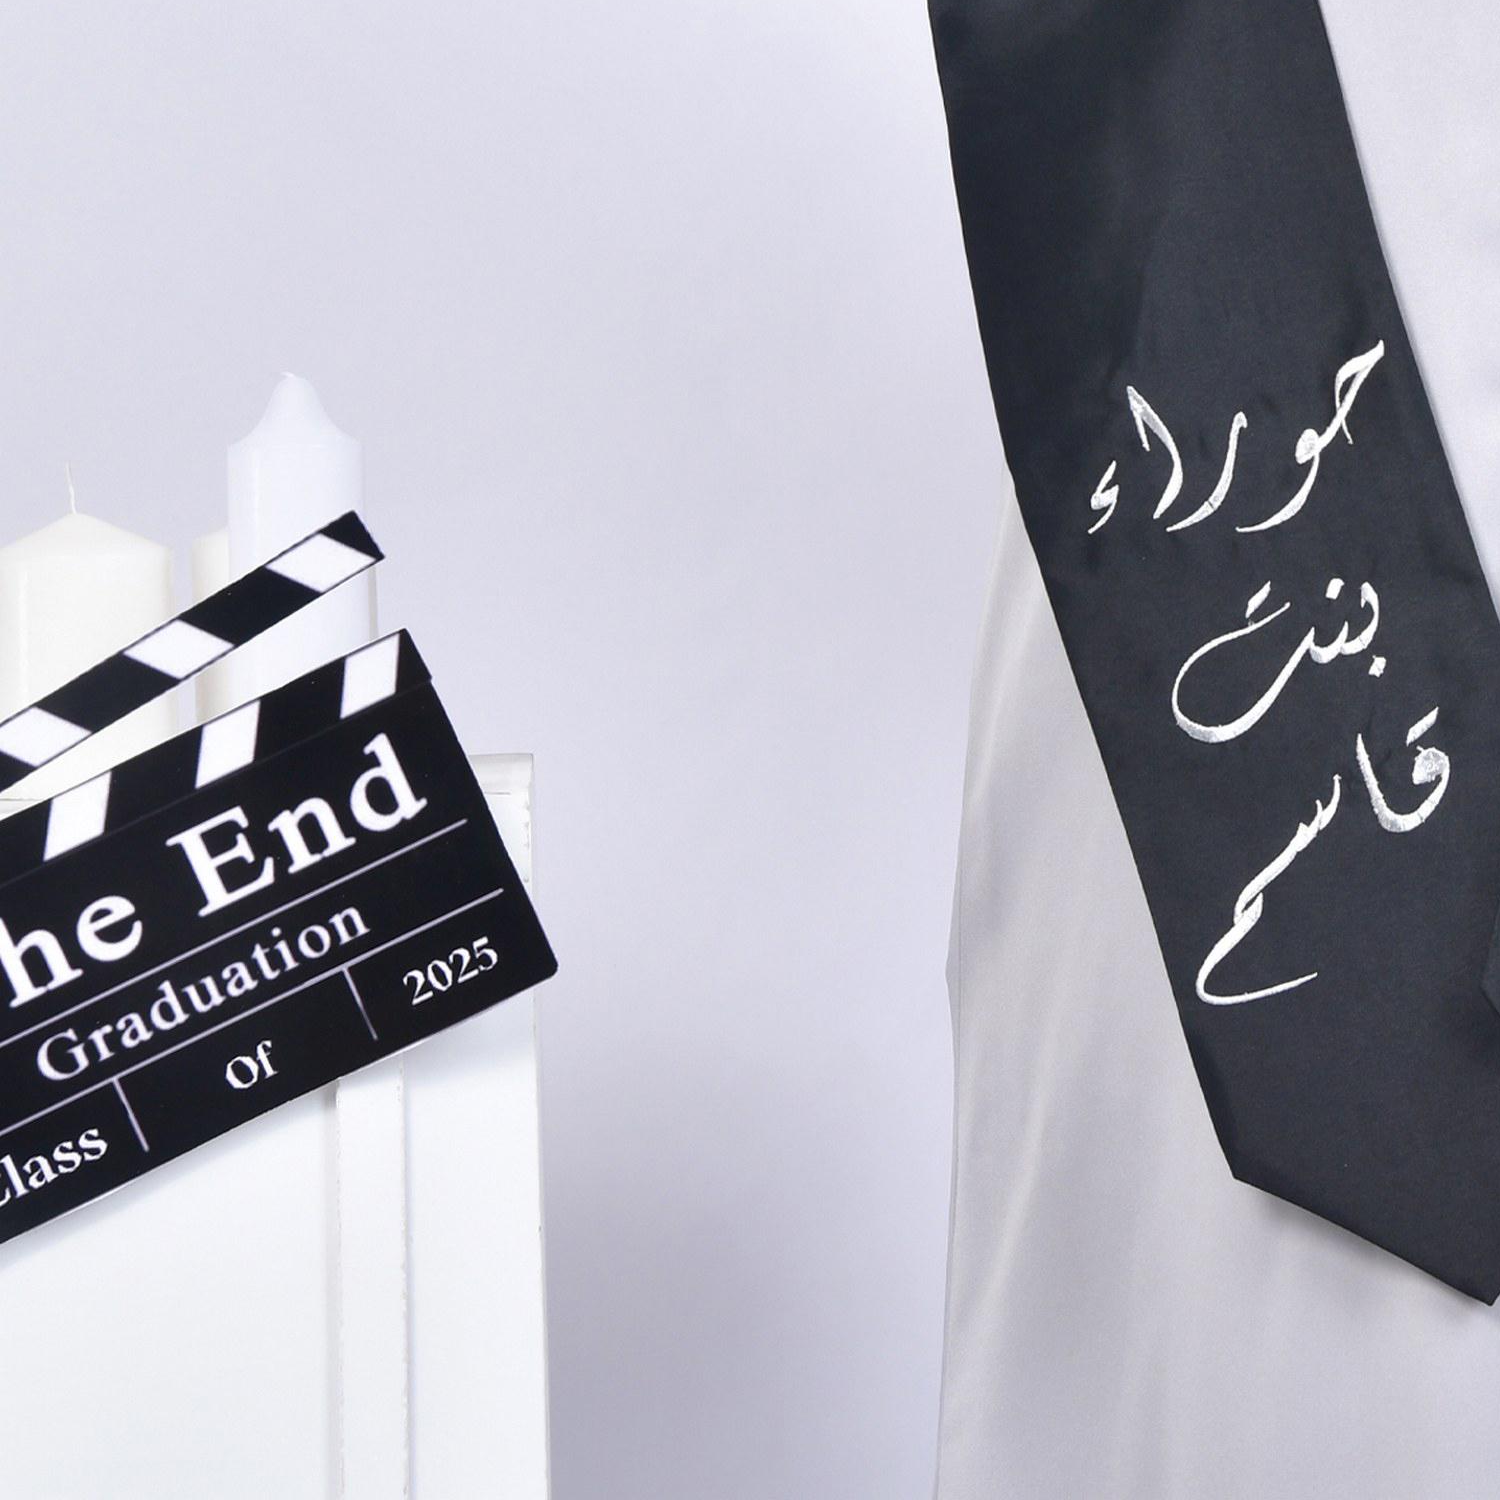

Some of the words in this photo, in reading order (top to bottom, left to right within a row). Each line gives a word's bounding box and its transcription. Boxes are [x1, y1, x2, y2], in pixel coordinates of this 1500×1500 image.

[1086, 338, 1385, 536] حوراء
[1170, 576, 1388, 745] بنت
[165, 732, 429, 918] End
[1195, 705, 1451, 1006] قاسم
[0, 1127, 109, 1207] lass
[224, 1040, 279, 1090] Of
[402, 936, 499, 1006] 2025
[35, 906, 371, 1082] Graduation
